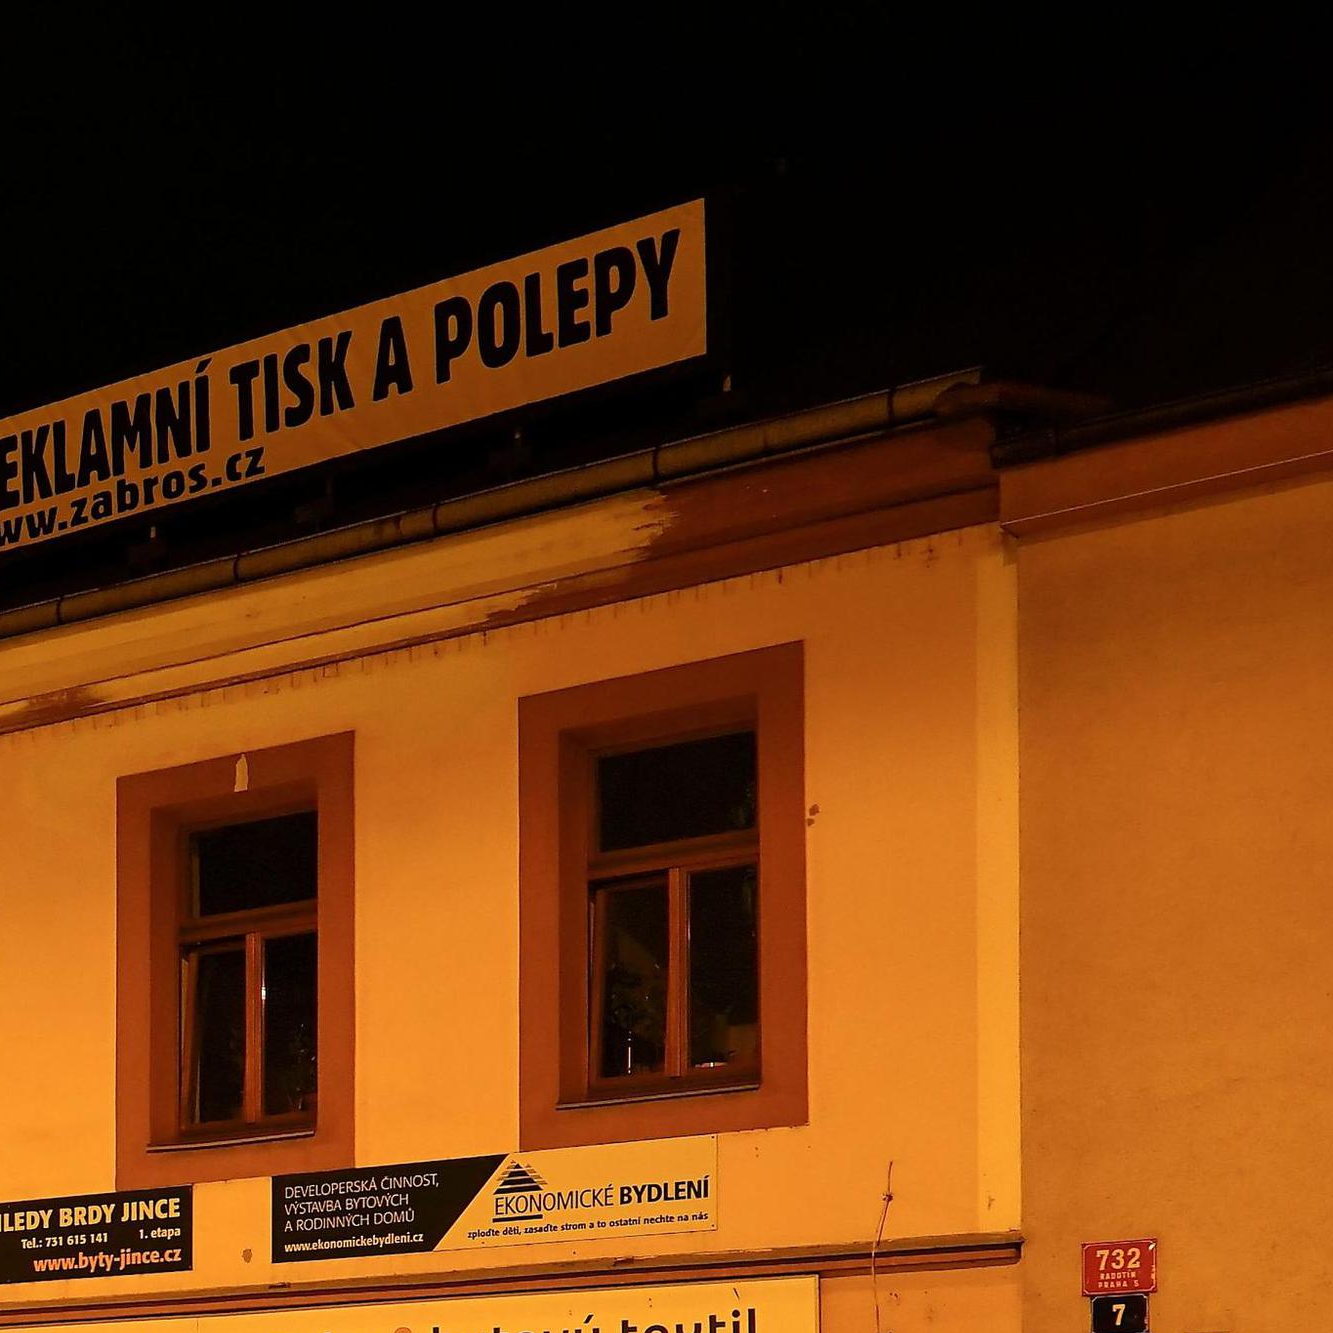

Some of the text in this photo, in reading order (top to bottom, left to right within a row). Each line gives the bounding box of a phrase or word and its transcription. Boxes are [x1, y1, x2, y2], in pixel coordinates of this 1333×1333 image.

[231, 330, 355, 442] TISK
[373, 315, 414, 403] A
[435, 229, 681, 384] POLEPY
[284, 1173, 439, 1199] DEVELOPERSKÁ ČINNOST,
[494, 1175, 710, 1216] EKONOMICKÉ BYDLENÍ
[58, 1203, 116, 1226] BRDY
[120, 1197, 181, 1222] JINCE
[284, 1191, 409, 1216] VÝSTAVBA BYTOVÝCH
[284, 1207, 415, 1232] A RODINNÝCH DOMŮ
[467, 1228, 500, 1240] zploďte
[502, 1224, 521, 1236] děti,
[560, 1222, 587, 1232] strom
[596, 1220, 607, 1228] to
[609, 1216, 641, 1227] ostatní
[643, 1213, 675, 1225] nechte
[691, 1211, 709, 1221] nás
[21, 1232, 109, 1250] Tel.: 731 615 141
[138, 1226, 181, 1241] 1. etapa
[284, 1231, 424, 1253] www.ekonomickebydleni.cz
[33, 1247, 182, 1275] www.byty-jince.cz
[1096, 1247, 1141, 1270] 732
[1098, 1280, 1128, 1288] PRAHA
[1100, 1269, 1136, 1280] RADOTÍN
[1112, 1303, 1126, 1326] 7
